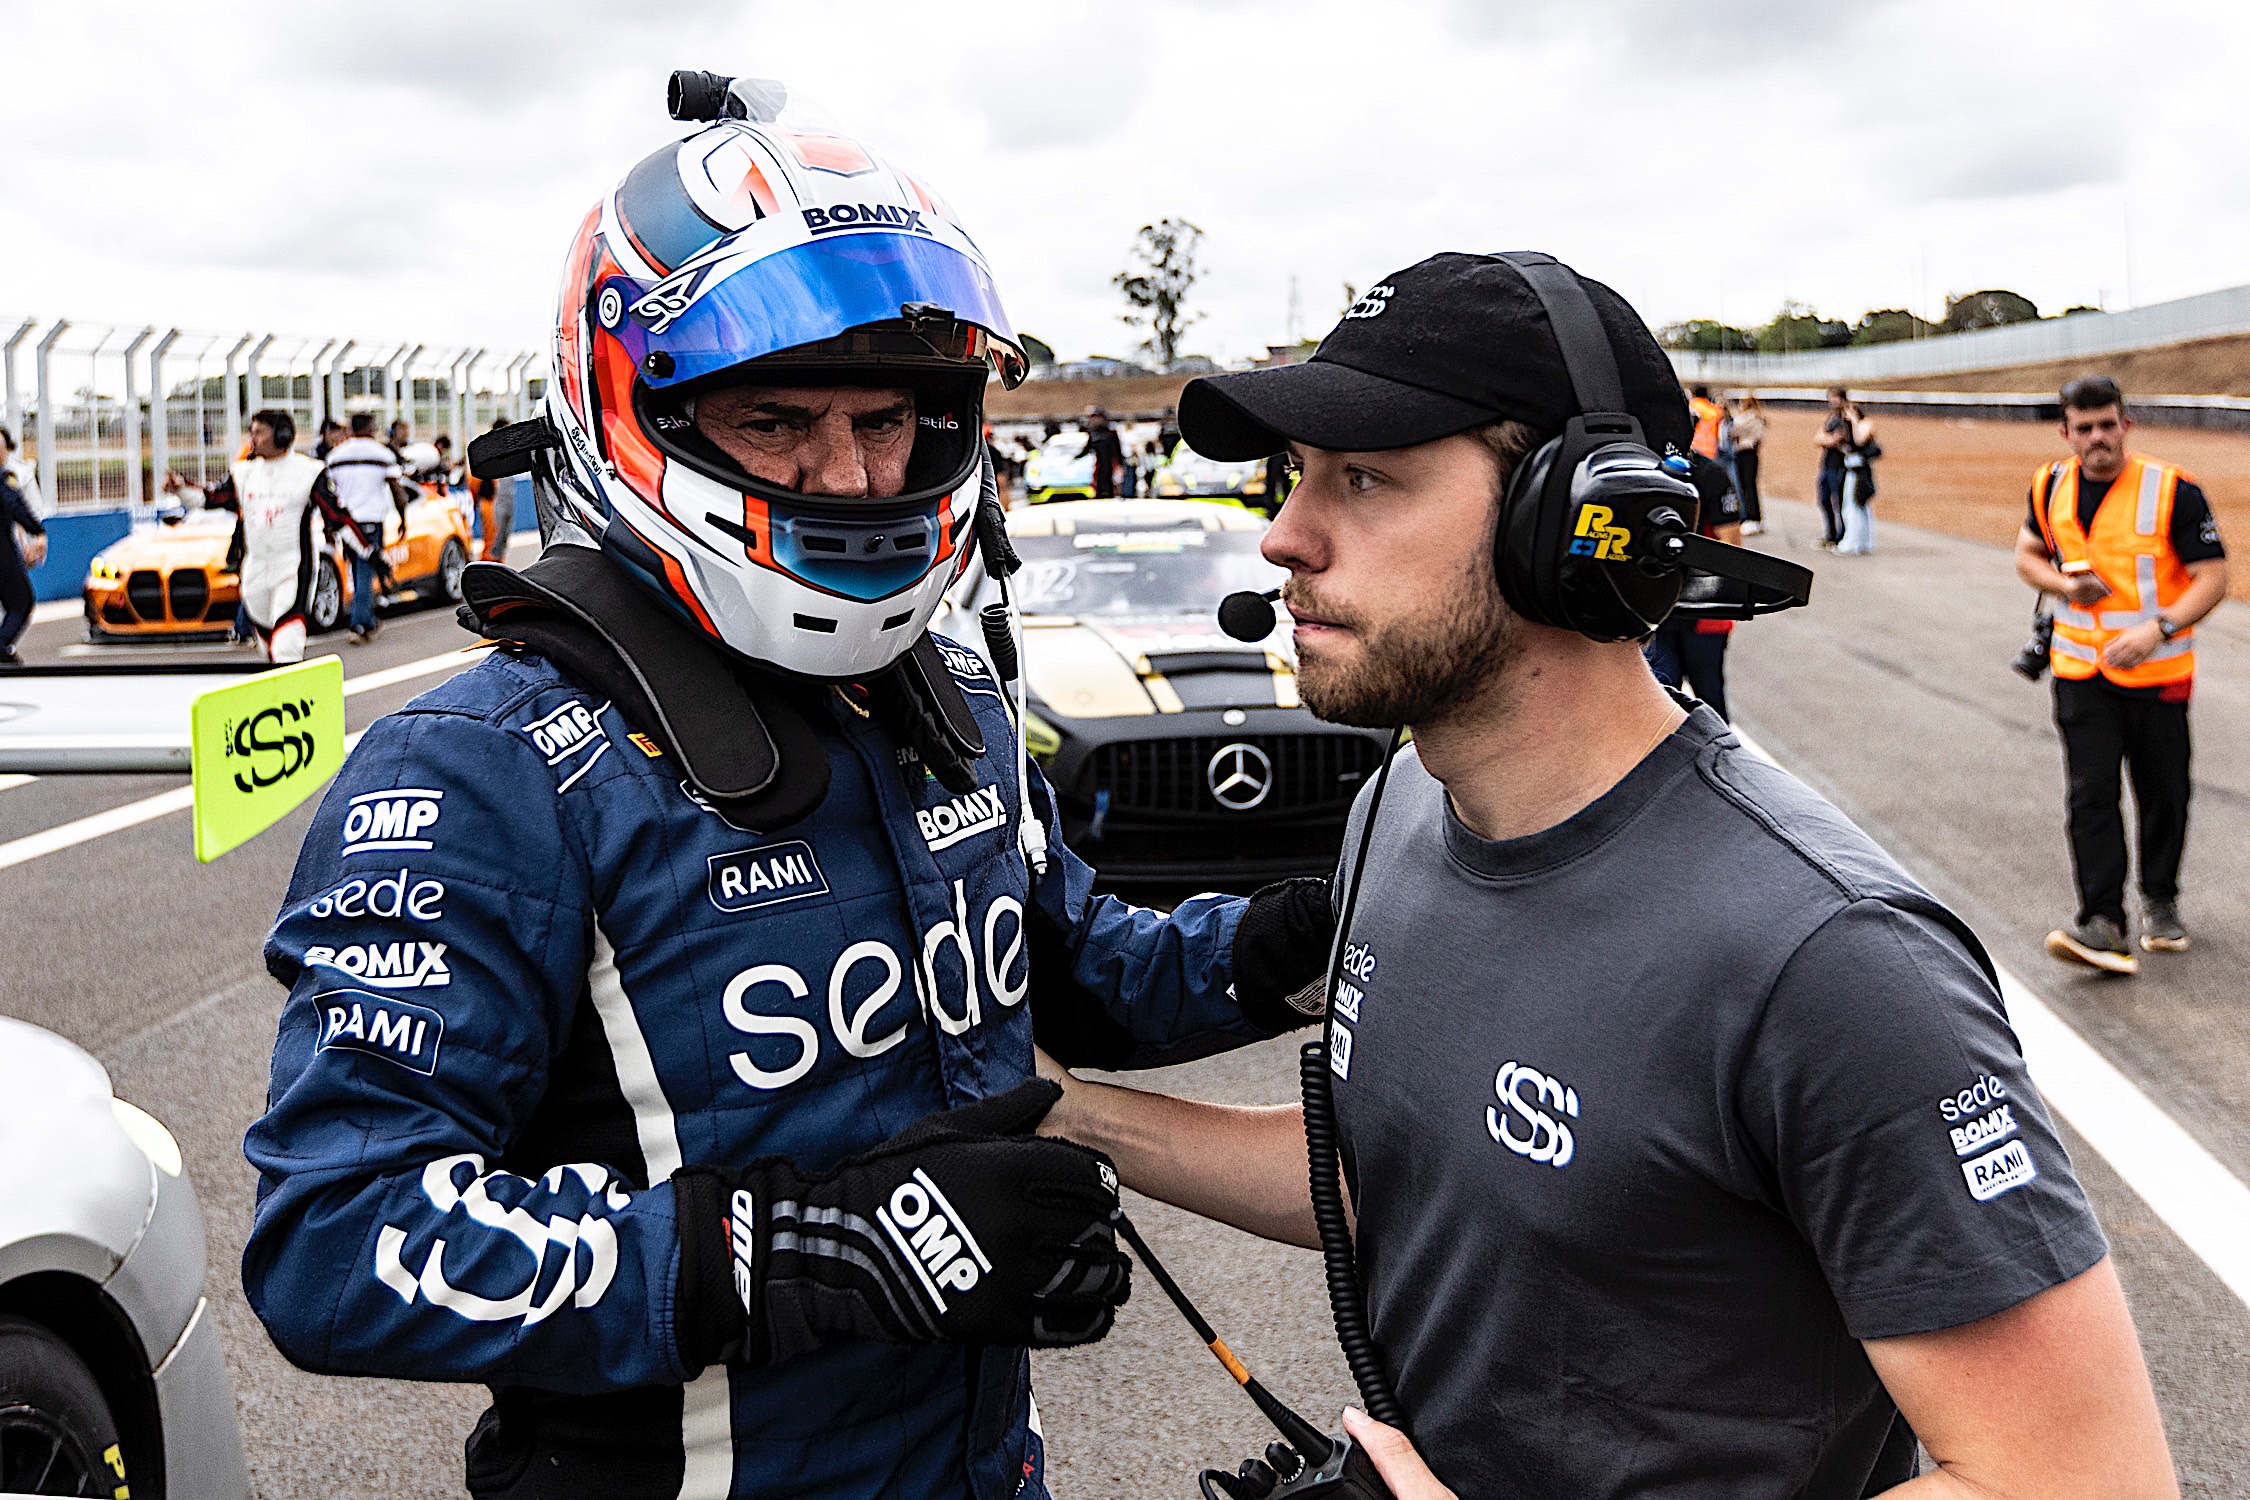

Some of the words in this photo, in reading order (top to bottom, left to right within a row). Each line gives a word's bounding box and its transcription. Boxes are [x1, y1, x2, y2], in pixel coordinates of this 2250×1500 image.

[801, 203, 931, 232] BOMIX
[919, 415, 959, 430] Stilo
[532, 705, 593, 757] OMP
[343, 799, 440, 843] OMP
[916, 784, 1006, 842] BOMIX
[310, 867, 445, 921] sede
[721, 854, 813, 900] RAMI
[304, 941, 450, 980] BOMIX
[1343, 942, 1376, 983] ede
[722, 878, 1028, 1090] sede
[323, 1003, 427, 1056] RAMI
[1939, 1074, 2005, 1121] sede
[1949, 1104, 2014, 1150] BOMIX
[1974, 1147, 2024, 1186] RAMI
[890, 1182, 979, 1292] OMP
